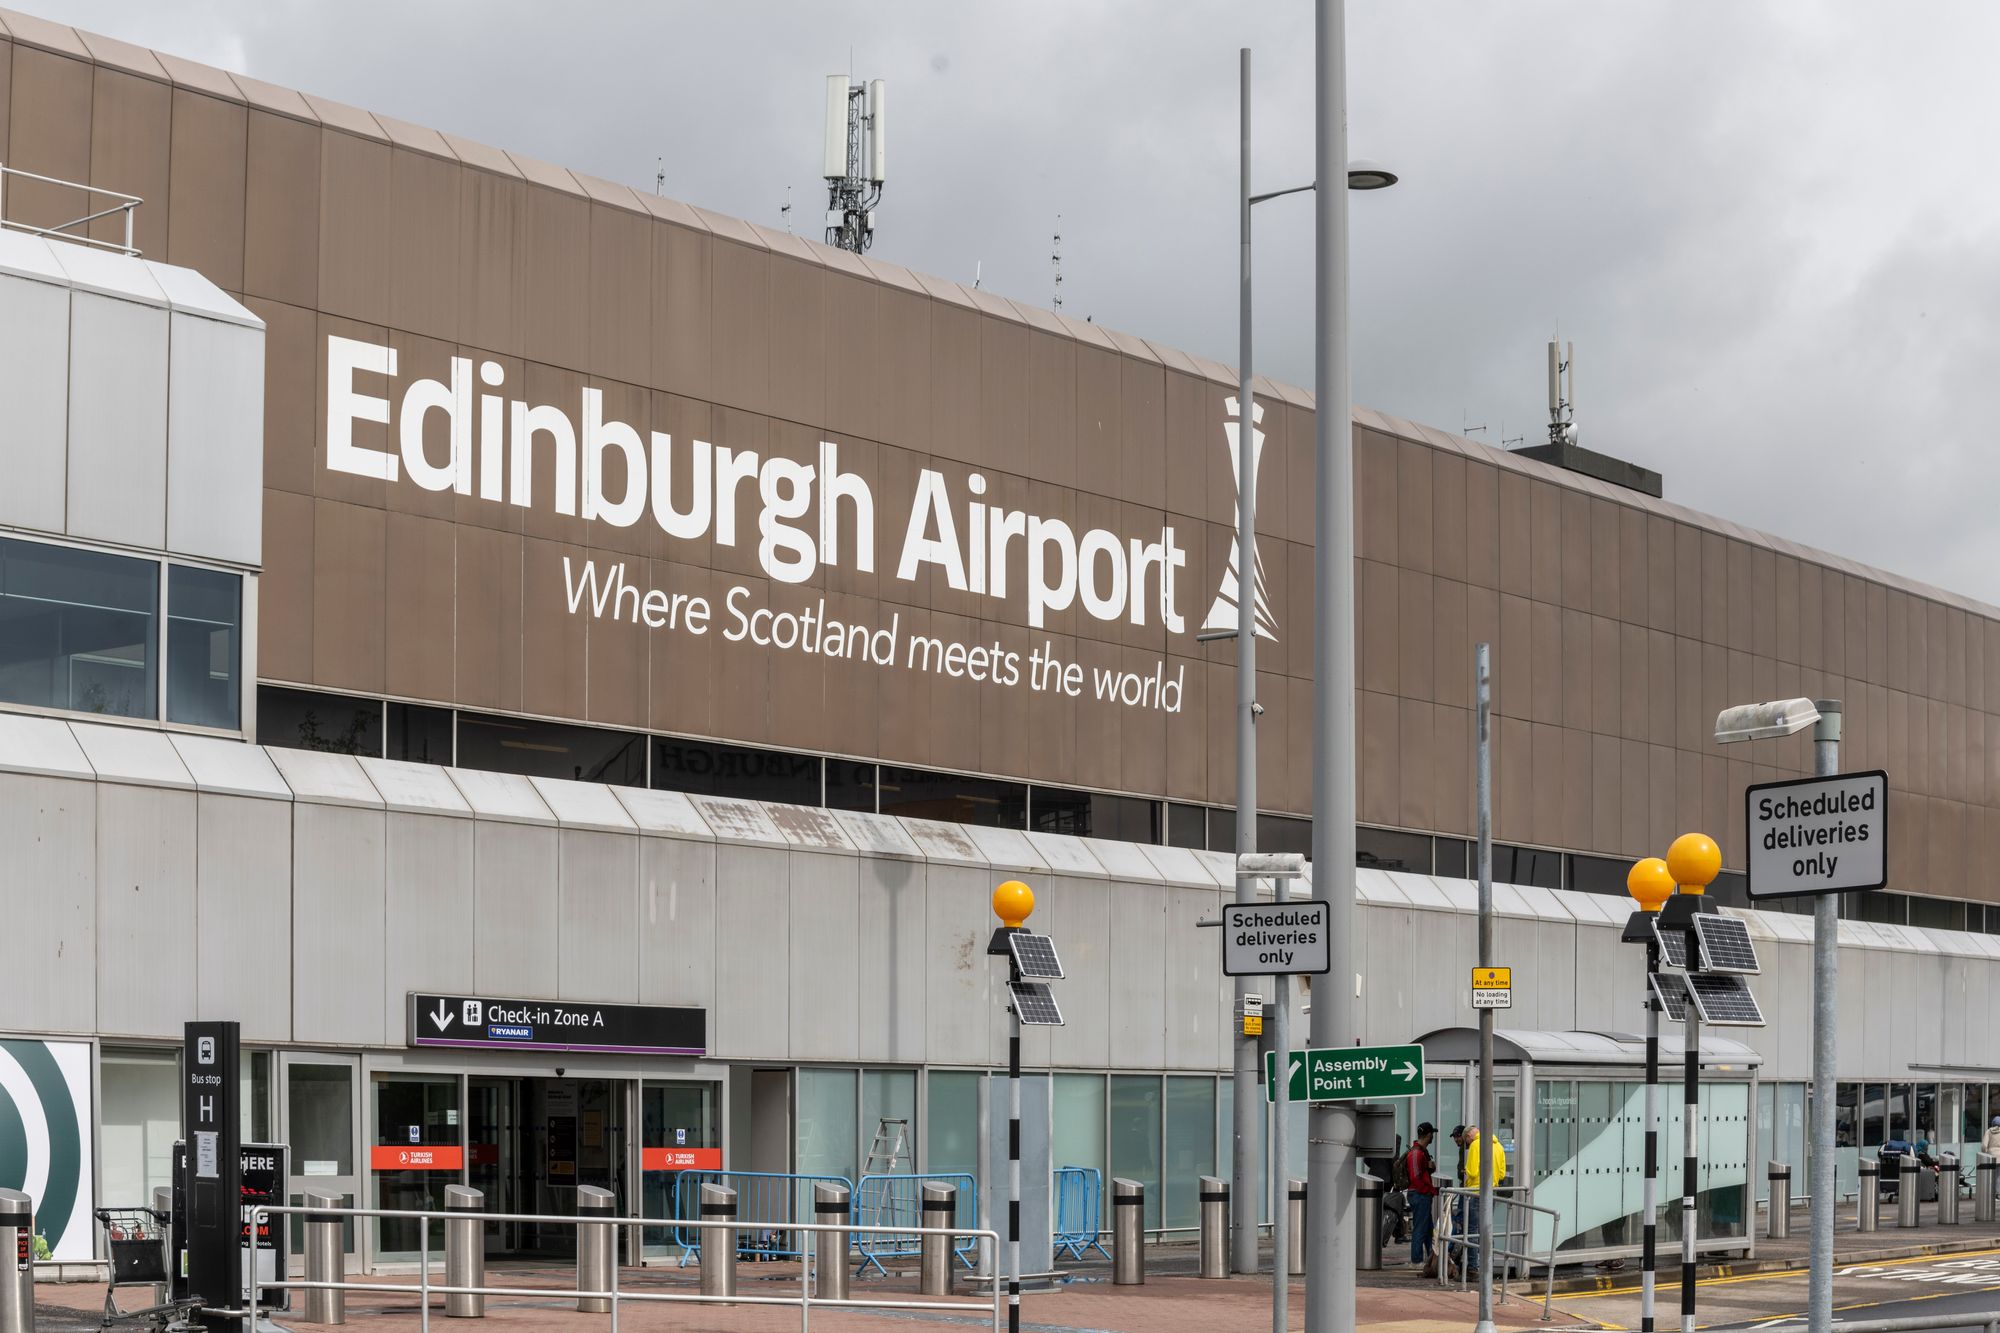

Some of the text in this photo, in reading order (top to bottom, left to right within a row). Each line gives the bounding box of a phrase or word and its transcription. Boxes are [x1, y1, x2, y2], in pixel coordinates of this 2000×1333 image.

[326, 334, 1186, 634] Edinburgh Airport
[563, 556, 1185, 713] Where Scotland meets the world
[1759, 787, 1875, 821] Scheduled
[1763, 820, 1869, 850] deliveries
[1792, 852, 1838, 878] only
[1232, 910, 1321, 928] Scheduled
[1236, 930, 1317, 946] deliveries
[1259, 949, 1294, 966] only
[488, 1005, 604, 1027] Check-in Zone A
[496, 1028, 529, 1037] RYANAIR
[1314, 1057, 1388, 1073] Assembly
[192, 1074, 221, 1086] Bus stop
[1314, 1076, 1365, 1090] Point 1
[200, 1095, 213, 1122] H
